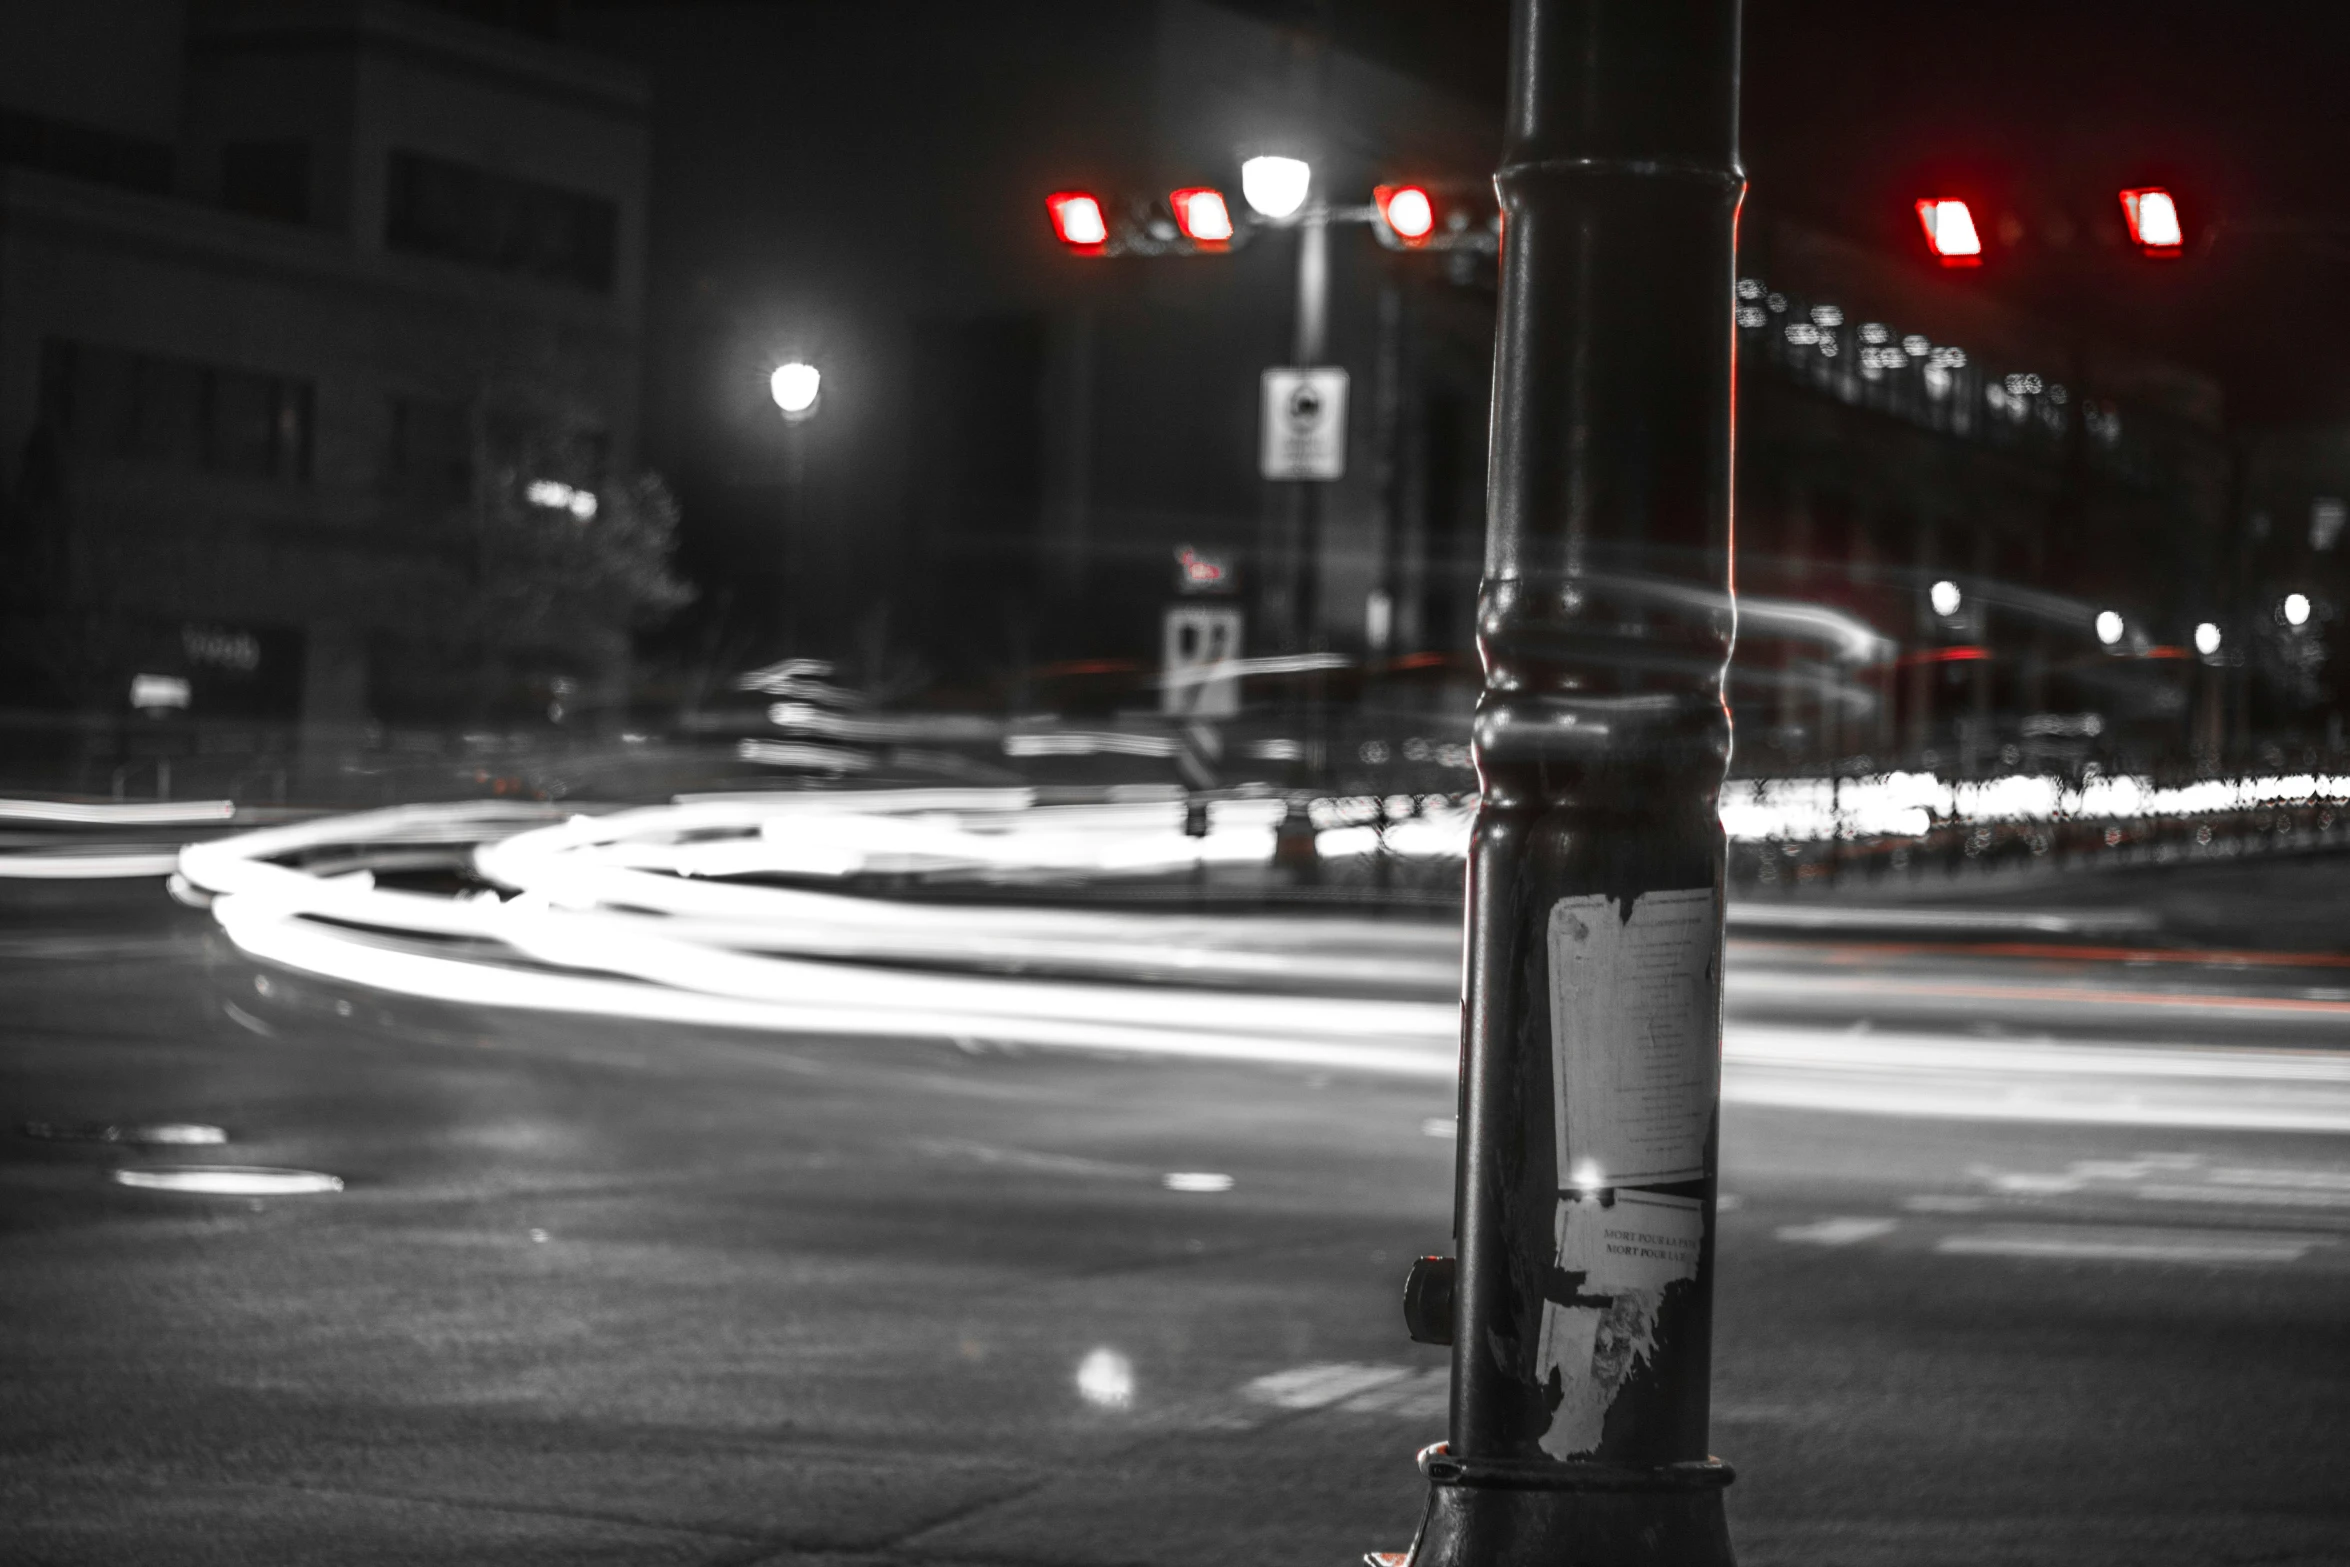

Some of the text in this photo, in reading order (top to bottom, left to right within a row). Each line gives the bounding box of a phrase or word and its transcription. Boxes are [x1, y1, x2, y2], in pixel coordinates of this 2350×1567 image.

[1604, 1229, 1636, 1241] MORT
[1638, 1233, 1664, 1245] POUR
[1666, 1237, 1677, 1247] LA
[1606, 1244, 1638, 1256] MORT
[1640, 1248, 1666, 1260] POUR
